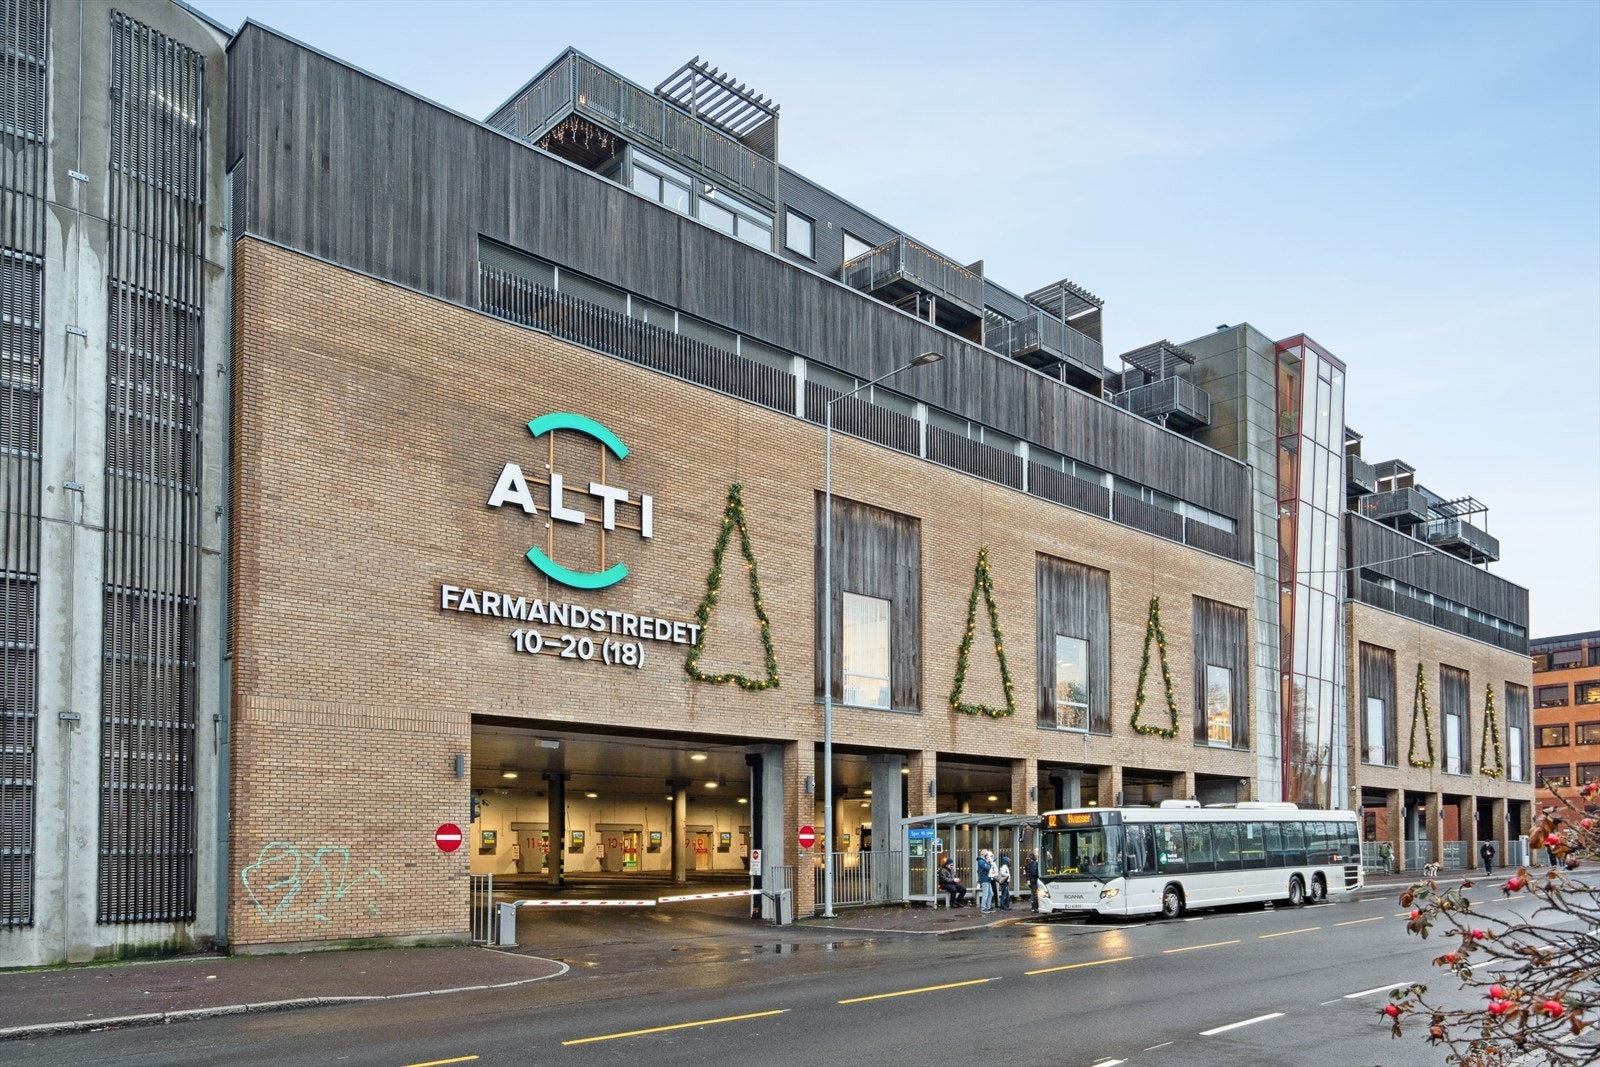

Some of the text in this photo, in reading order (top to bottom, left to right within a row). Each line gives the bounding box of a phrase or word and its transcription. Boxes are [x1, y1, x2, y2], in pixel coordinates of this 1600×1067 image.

[487, 463, 653, 538] ALTI
[441, 584, 701, 645] FARMANDSTREDET
[602, 637, 645, 669] (18)
[526, 838, 535, 848] 11
[608, 838, 618, 848] 10
